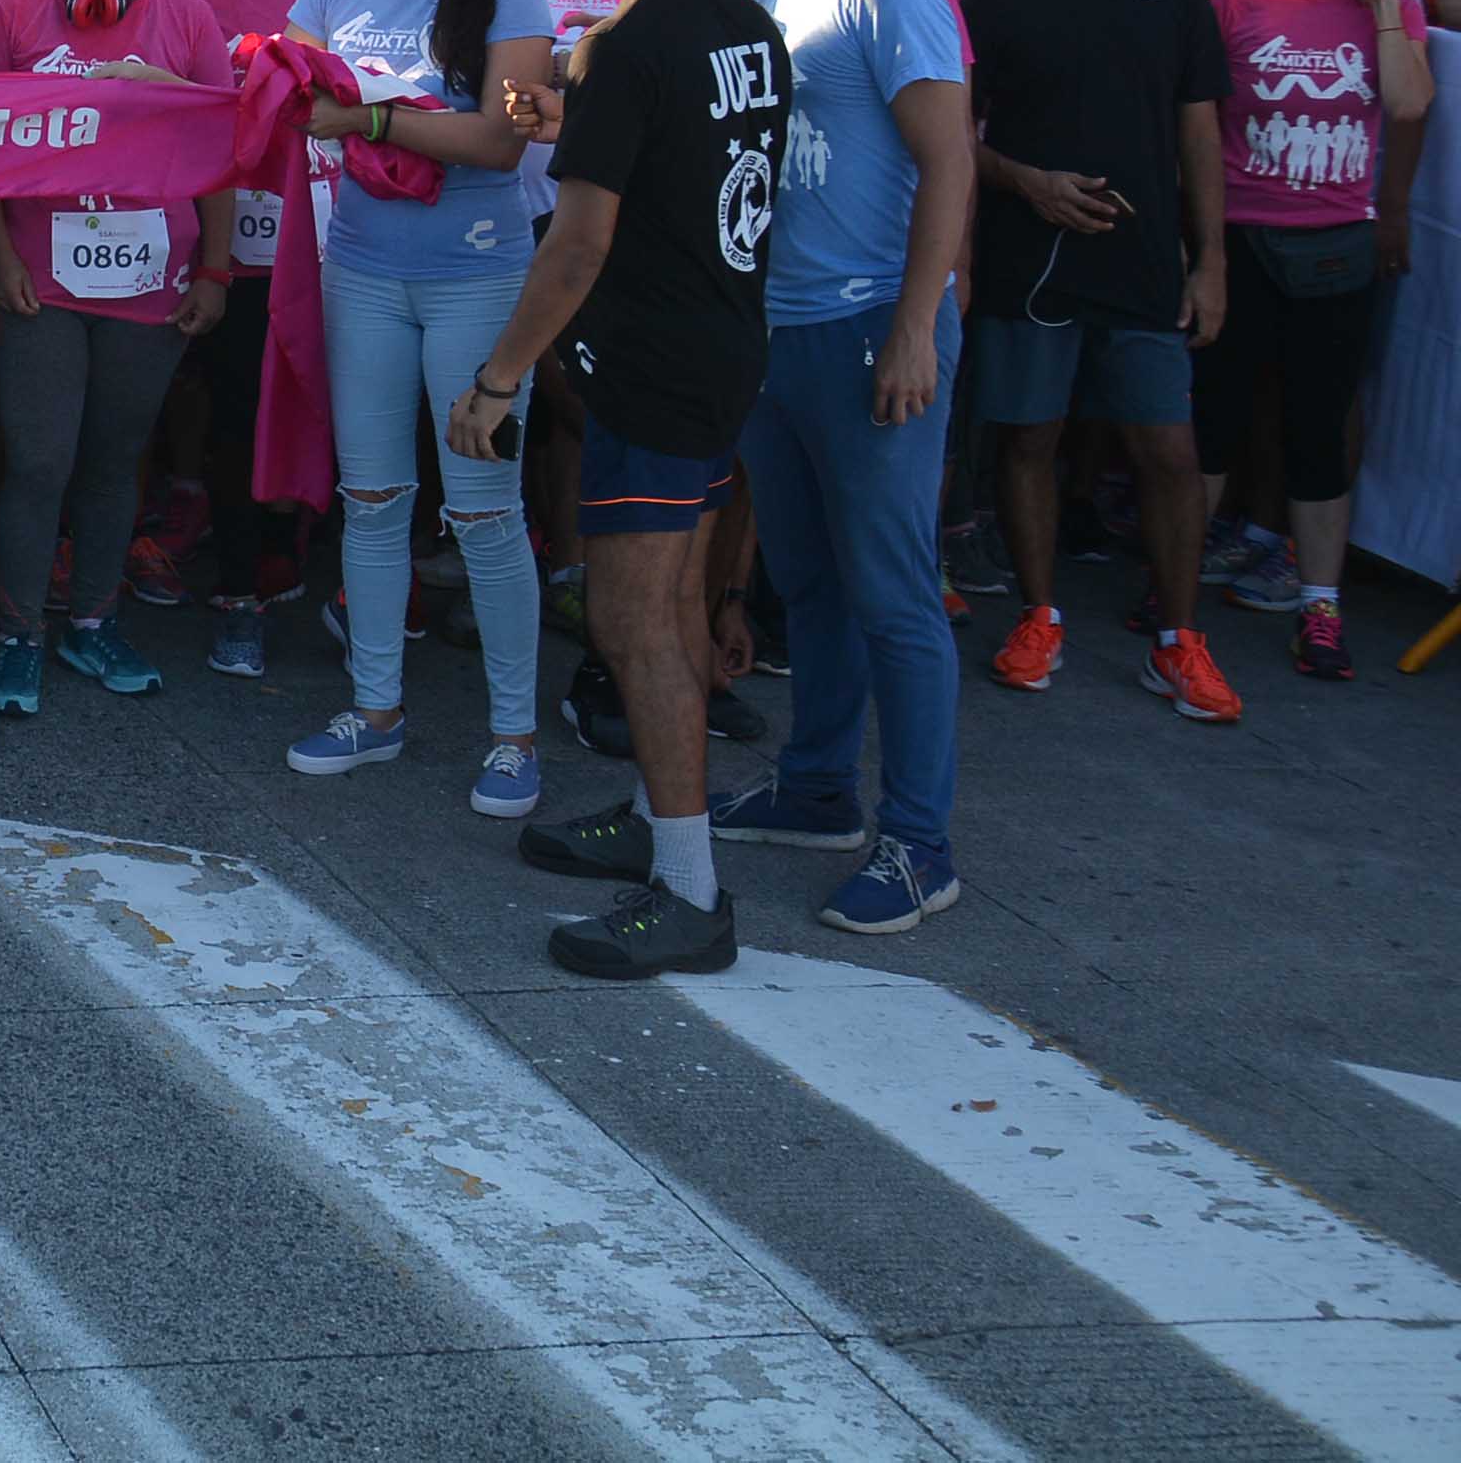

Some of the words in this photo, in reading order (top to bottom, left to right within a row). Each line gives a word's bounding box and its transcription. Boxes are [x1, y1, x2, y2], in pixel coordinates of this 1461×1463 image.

[354, 33, 420, 49] MIXTA
[1277, 54, 1338, 69] MIXTA
[708, 41, 779, 120] JUEZ
[238, 214, 277, 239] 09
[72, 242, 152, 269] 0864
